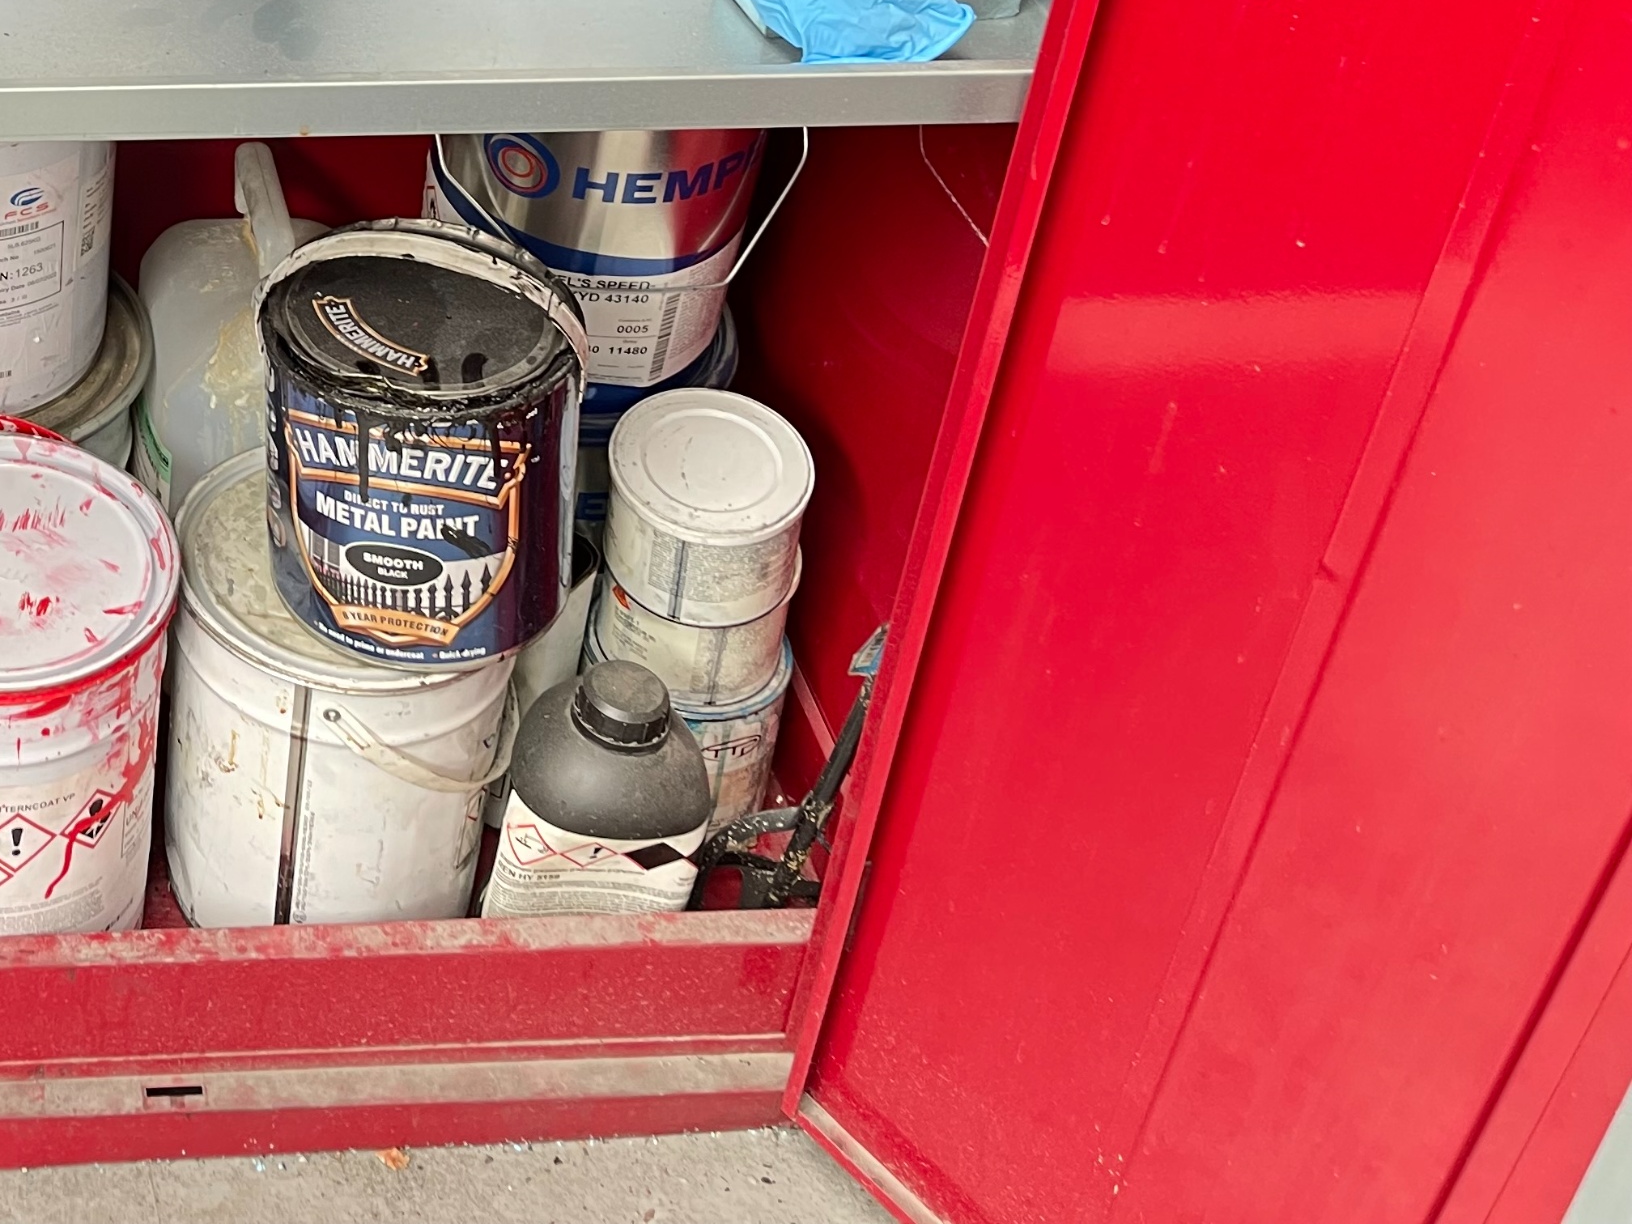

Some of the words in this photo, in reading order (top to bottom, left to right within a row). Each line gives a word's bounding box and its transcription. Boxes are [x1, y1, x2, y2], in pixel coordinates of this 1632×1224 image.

[4, 202, 50, 221] FCS
[604, 293, 650, 304] 43140
[325, 303, 416, 368] HAMMERITE
[616, 325, 649, 334] 0005
[608, 346, 648, 355] 11480
[315, 491, 396, 538] METAL
[410, 503, 445, 516] RUST
[363, 551, 424, 572] SMOOTH
[377, 566, 410, 580] BLACK
[351, 612, 378, 624] YEAR
[380, 616, 449, 637] PROTECTION
[62, 793, 76, 802] VP
